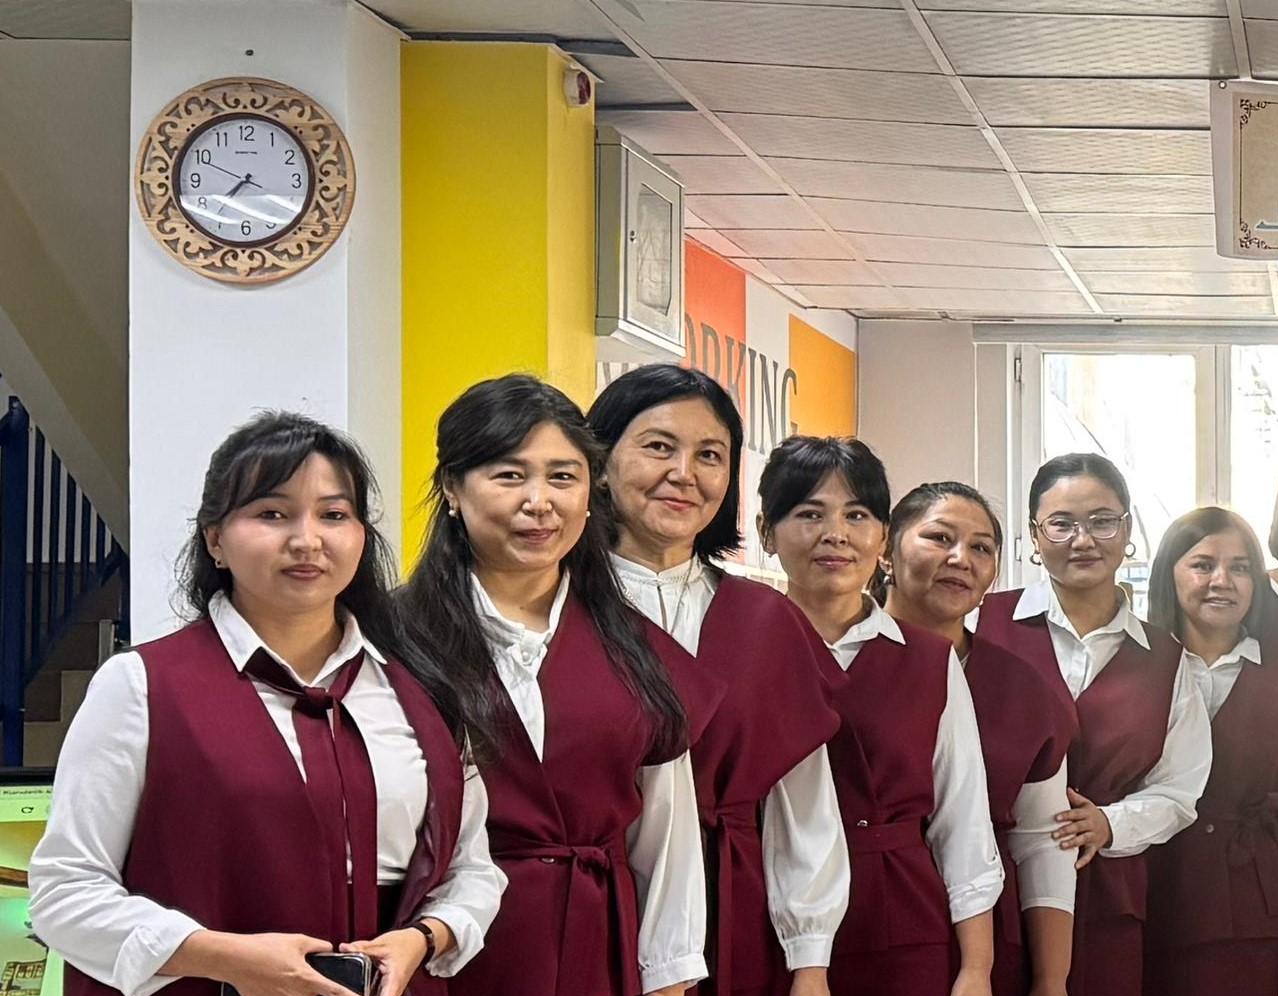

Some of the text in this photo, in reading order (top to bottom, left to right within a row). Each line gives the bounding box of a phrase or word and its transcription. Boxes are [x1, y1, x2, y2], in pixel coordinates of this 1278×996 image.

[216, 131, 228, 147] 11
[239, 125, 255, 141] 12
[270, 131, 274, 147] 1
[195, 149, 212, 165] 10
[285, 149, 296, 165] 2
[190, 172, 201, 188] 9
[291, 173, 302, 189] 3
[241, 220, 251, 236] 6
